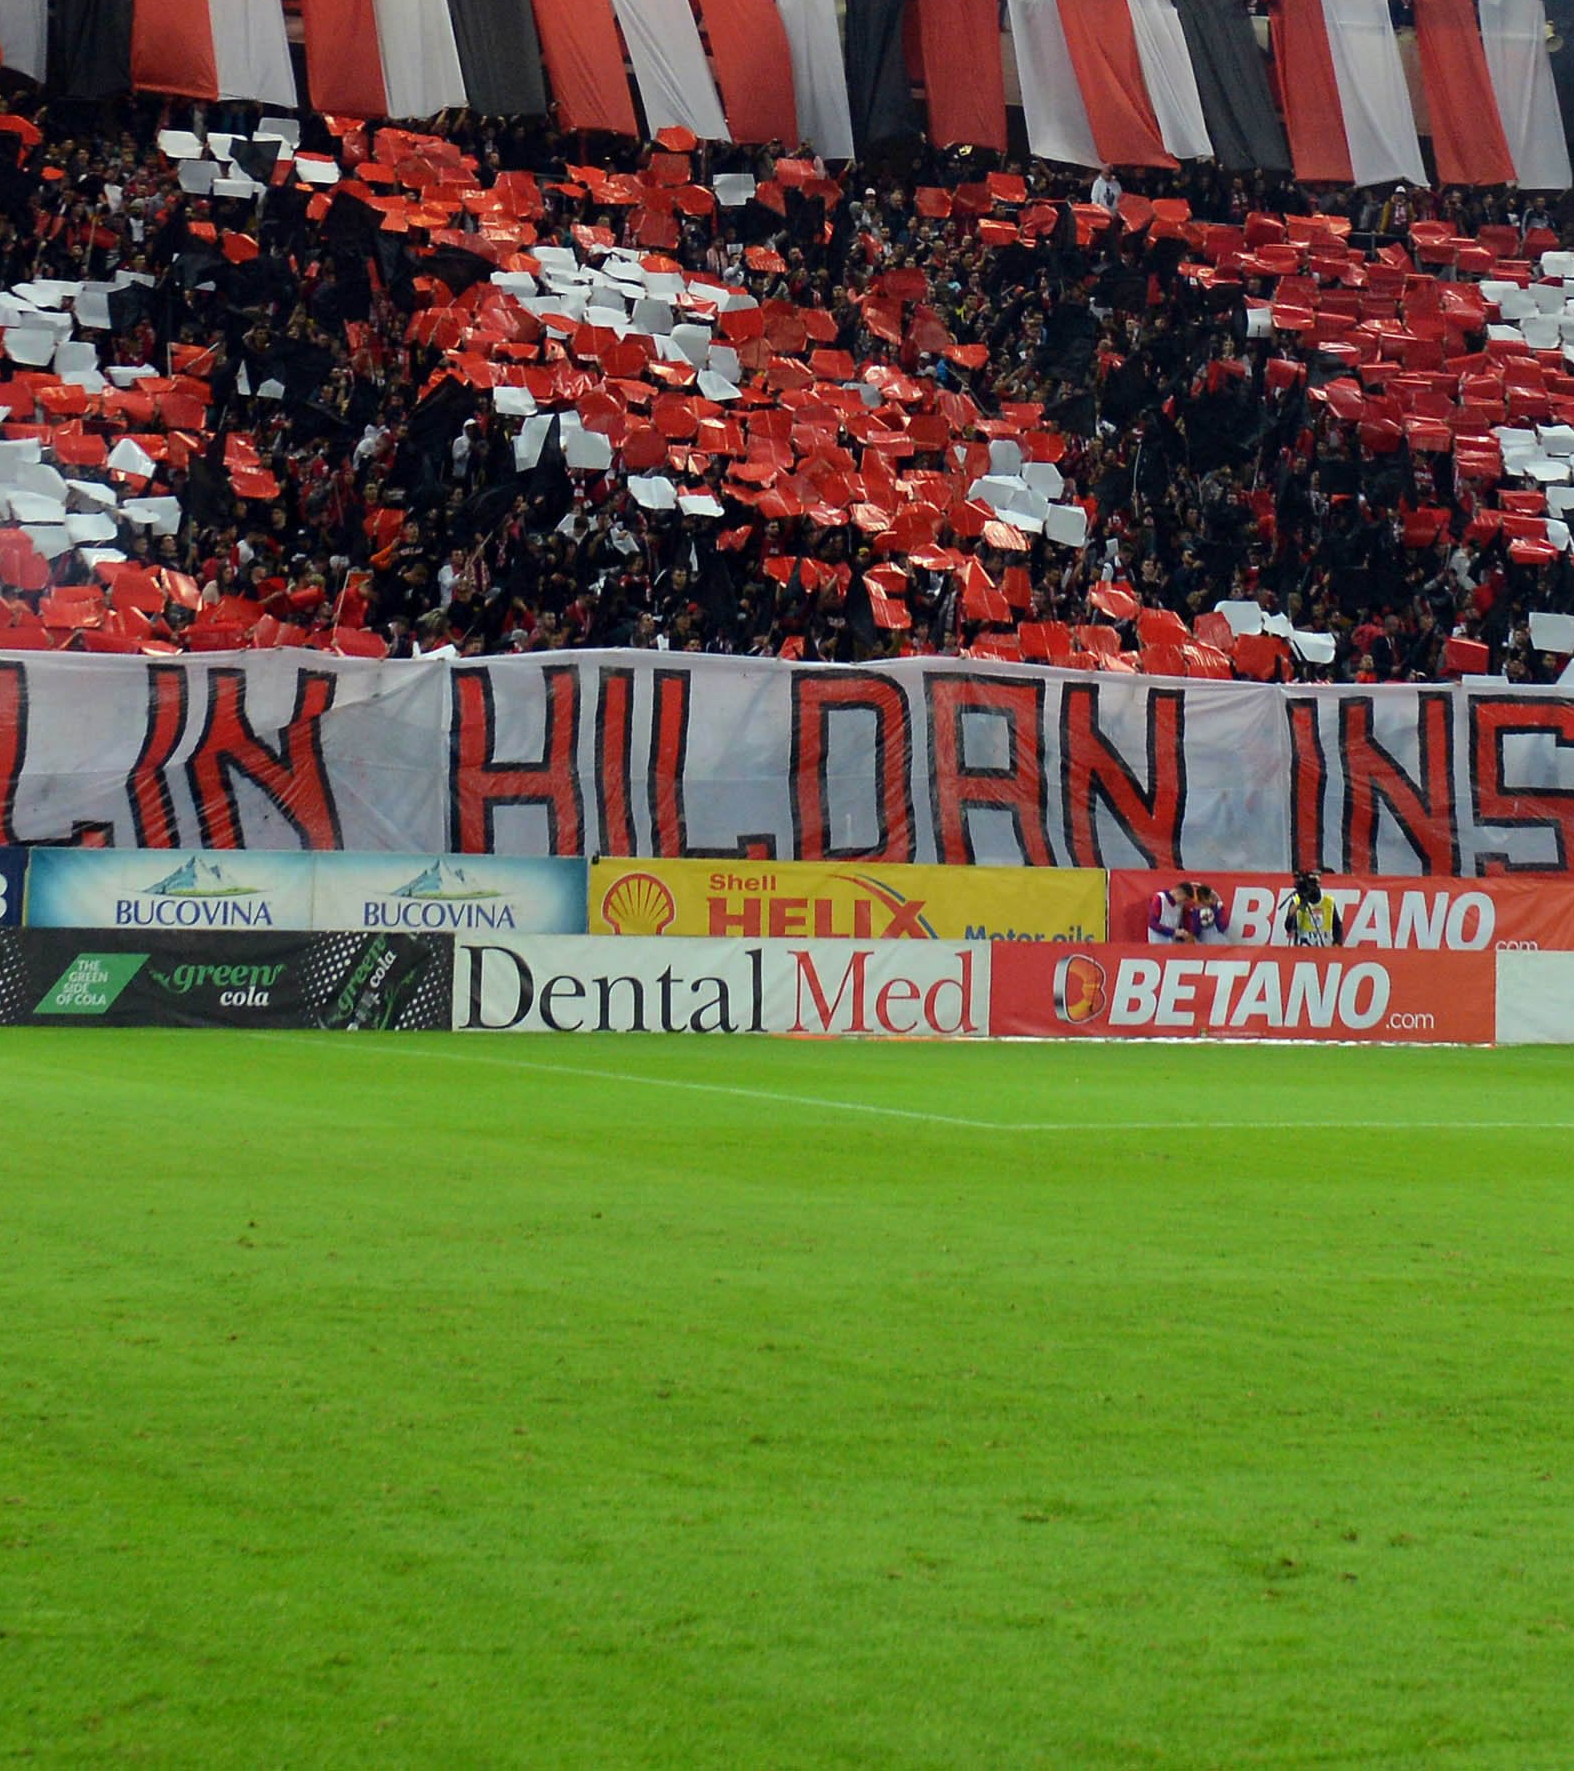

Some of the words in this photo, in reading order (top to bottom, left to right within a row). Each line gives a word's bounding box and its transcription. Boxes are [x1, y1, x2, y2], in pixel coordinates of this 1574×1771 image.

[448, 664, 1188, 872] HILDAN
[709, 873, 777, 892] Shell
[116, 899, 273, 926] BUCOVINA
[363, 901, 516, 928] BUCOVINA
[706, 896, 928, 939] HELIX
[68, 970, 109, 983] GREEN
[77, 959, 102, 971] THE
[368, 948, 397, 989] cola
[63, 982, 90, 995] SIDE
[171, 963, 287, 995] green
[56, 994, 74, 1006] OF
[75, 994, 107, 1006] COLA
[219, 985, 270, 1007] cola
